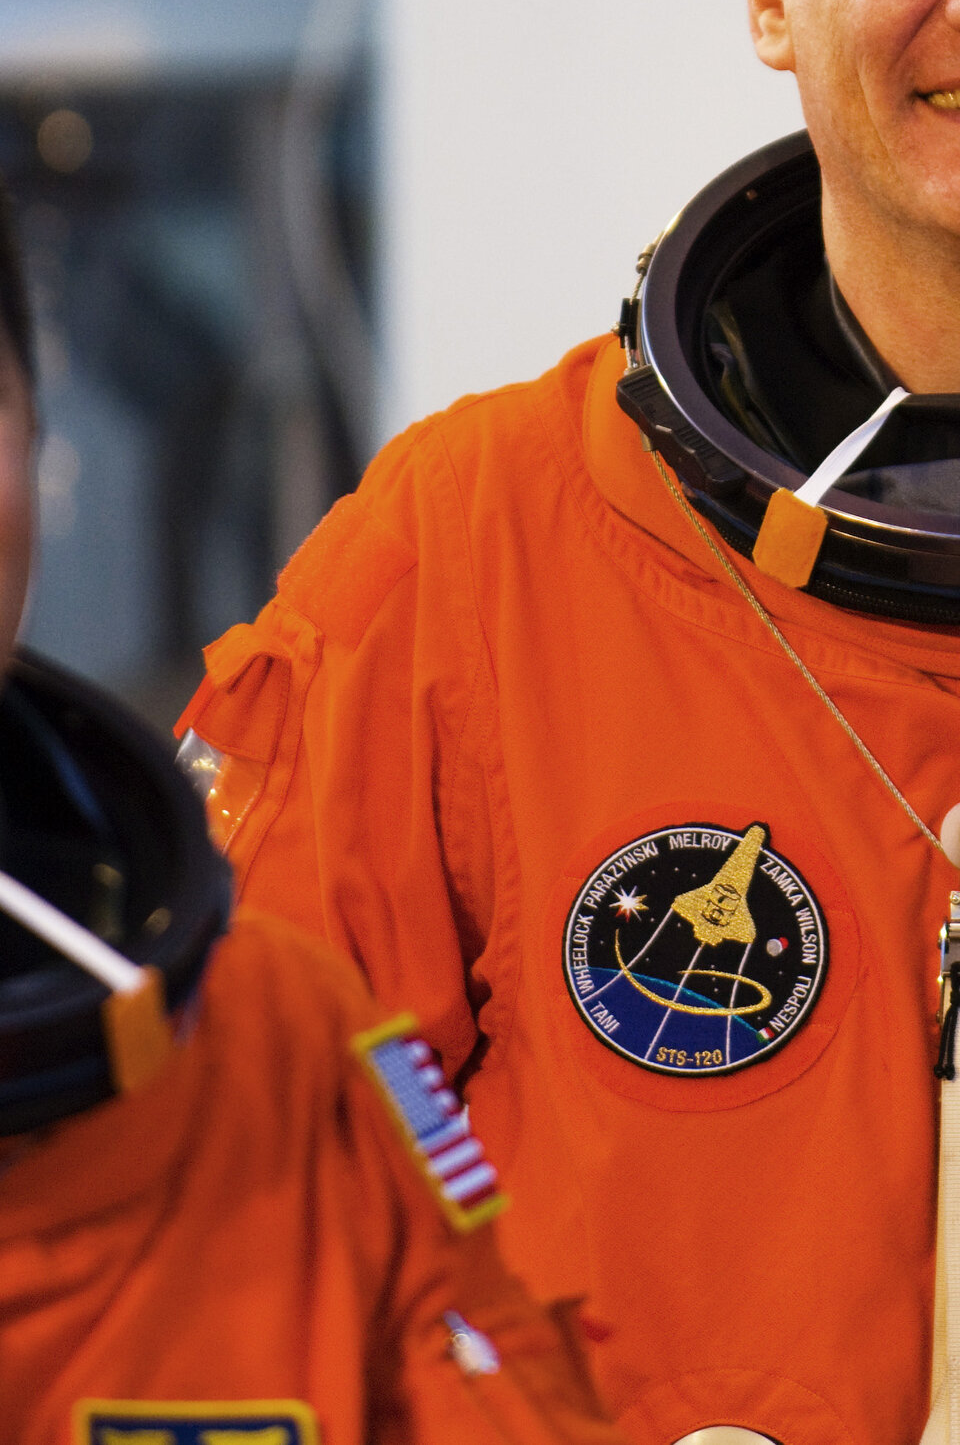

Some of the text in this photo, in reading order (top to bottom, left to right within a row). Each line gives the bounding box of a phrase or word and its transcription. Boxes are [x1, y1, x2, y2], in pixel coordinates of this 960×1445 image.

[574, 833, 818, 995] WHEELOCK PARAZYNSKI MELROY ZAMKA WILSON
[589, 975, 812, 1034] TANI NESPOLI
[656, 1046, 723, 1067] STS-120
